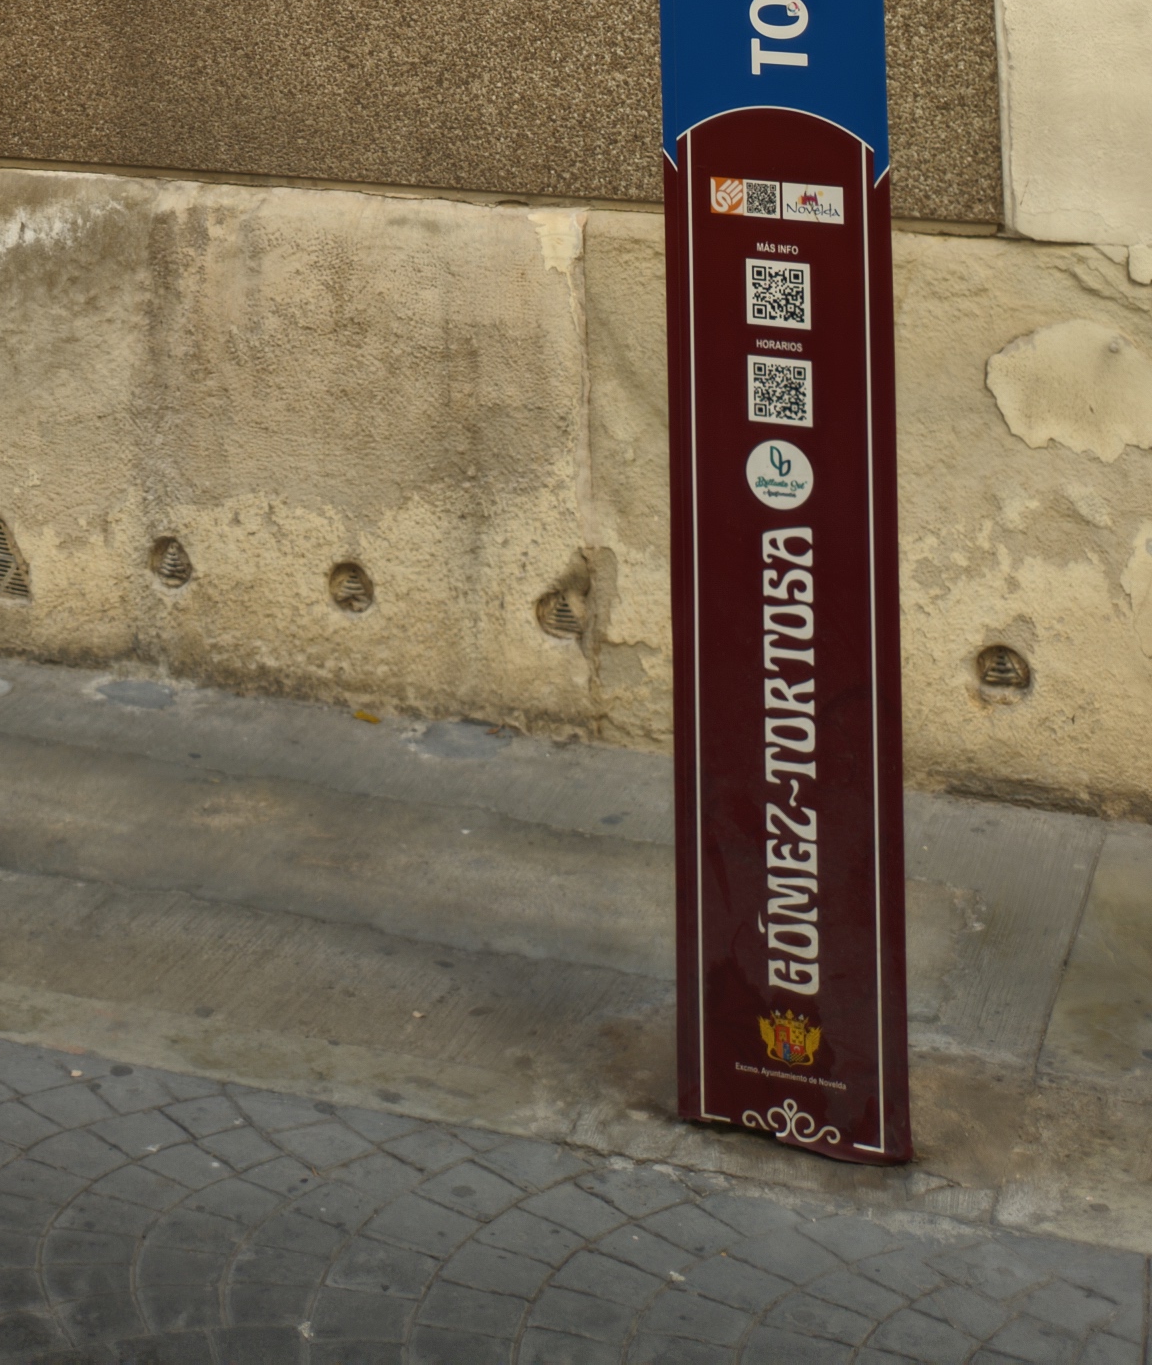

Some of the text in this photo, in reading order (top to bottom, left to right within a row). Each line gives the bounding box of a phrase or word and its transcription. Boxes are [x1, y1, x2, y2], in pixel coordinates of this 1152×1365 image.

[786, 201, 841, 218] Novelda
[756, 241, 799, 255] MÁS INFO
[756, 338, 803, 353] HORARIOS
[735, 1062, 847, 1090] Excmo. Ayuntamiento de Novelda
